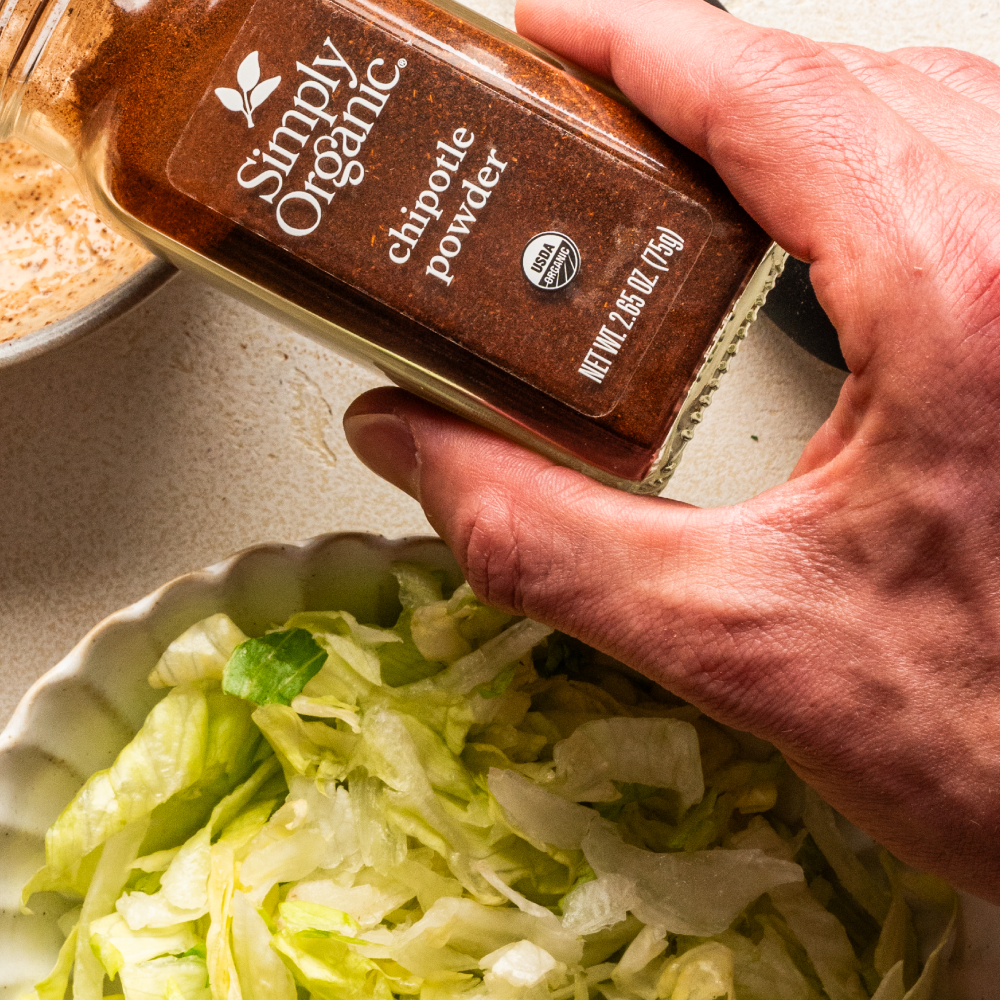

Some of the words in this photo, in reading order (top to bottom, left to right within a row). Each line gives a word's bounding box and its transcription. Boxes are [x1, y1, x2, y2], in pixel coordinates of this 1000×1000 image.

[237, 36, 357, 204] Simply
[388, 127, 475, 264] chipotle
[425, 149, 508, 286] powder
[530, 243, 555, 273] USDA
[544, 246, 570, 284] ORGANIC
[641, 226, 685, 272] (75g)
[627, 268, 660, 295] OZ.
[609, 289, 645, 330] 2.65
[592, 324, 627, 356] WT.
[578, 348, 612, 384] NET
